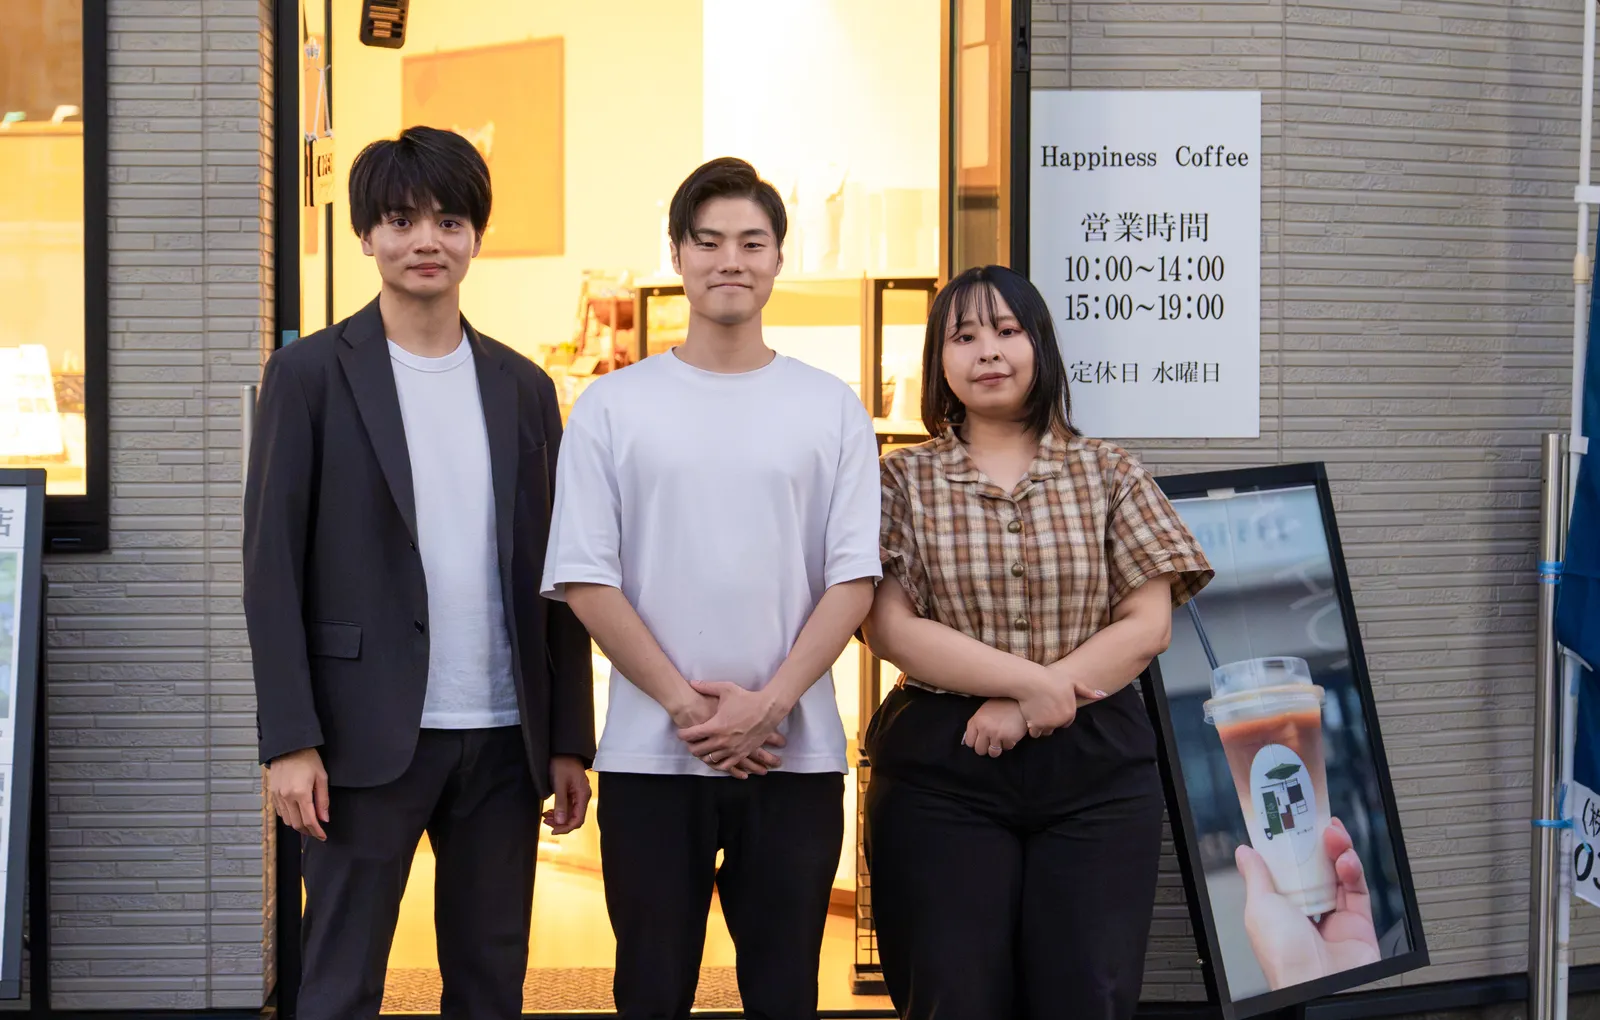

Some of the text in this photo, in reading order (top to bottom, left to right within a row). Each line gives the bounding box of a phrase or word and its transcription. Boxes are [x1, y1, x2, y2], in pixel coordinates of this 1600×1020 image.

[1040, 145, 1249, 171] Happiness Coffee
[1080, 211, 1209, 243] 営業時間
[1069, 360, 1220, 384] 定休日 水曜日
